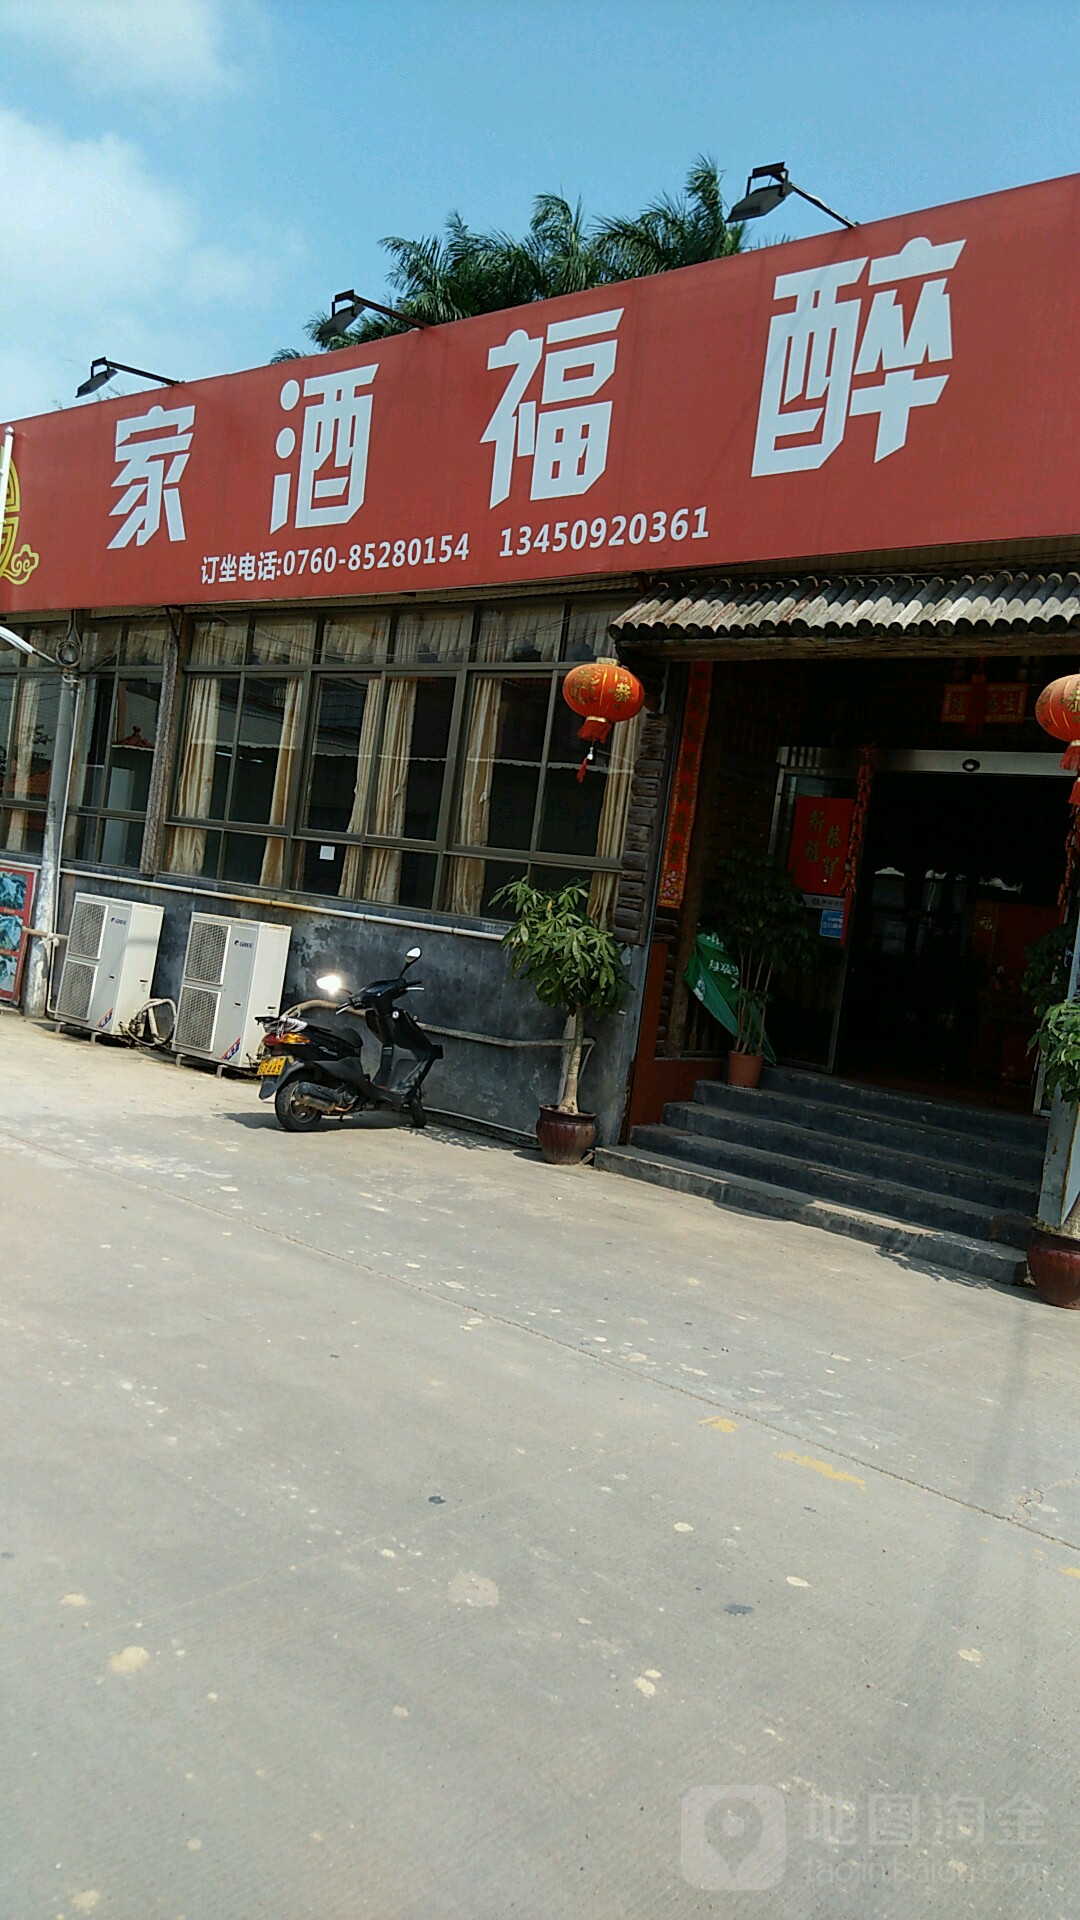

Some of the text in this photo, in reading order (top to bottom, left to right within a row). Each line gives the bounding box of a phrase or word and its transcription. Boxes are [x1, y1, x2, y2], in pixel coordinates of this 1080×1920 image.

[201, 506, 710, 585] 订坐电话:0760-85280154 13450920361
[239, 940, 254, 949] GREE
